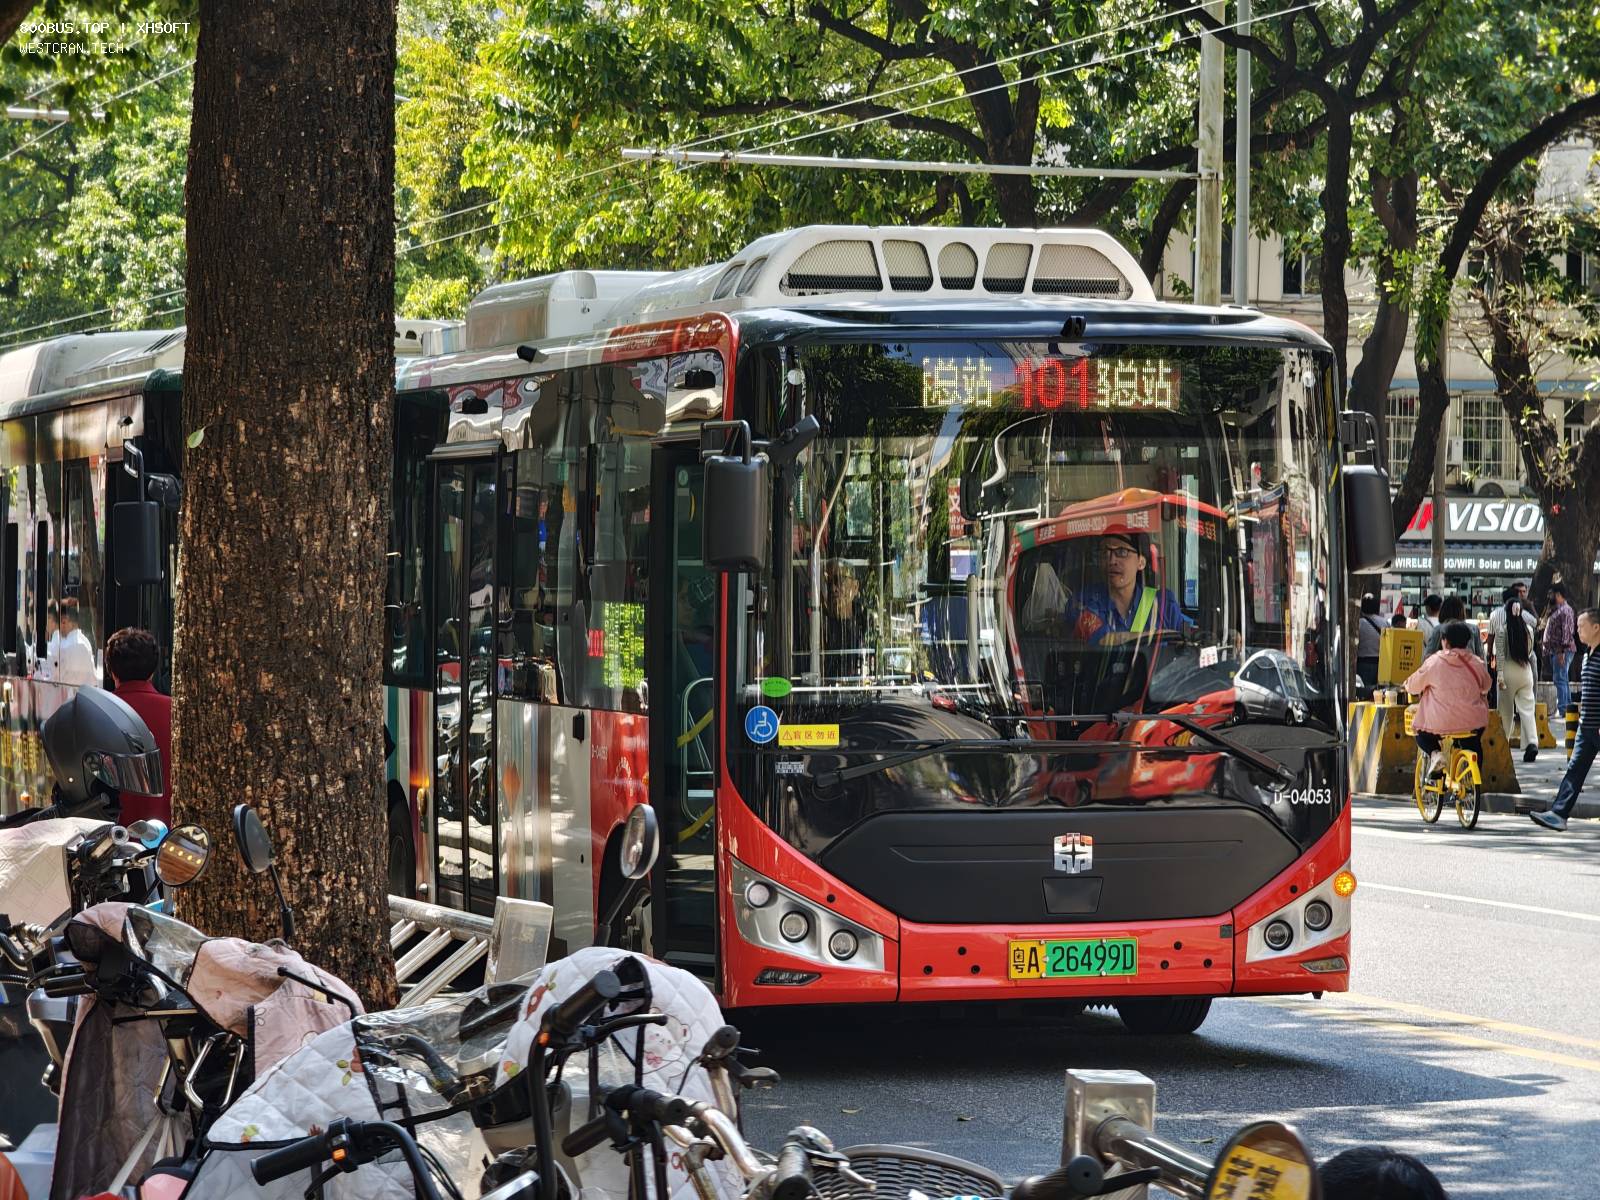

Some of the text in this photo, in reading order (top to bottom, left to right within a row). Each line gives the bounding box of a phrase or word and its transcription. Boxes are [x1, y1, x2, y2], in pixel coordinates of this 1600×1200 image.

[1015, 357, 1089, 409] 101
[1479, 558, 1501, 570] Solar
[1504, 558, 1523, 570] Dual
[1274, 788, 1331, 805] D-04053
[1052, 943, 1135, 973] 26499D
